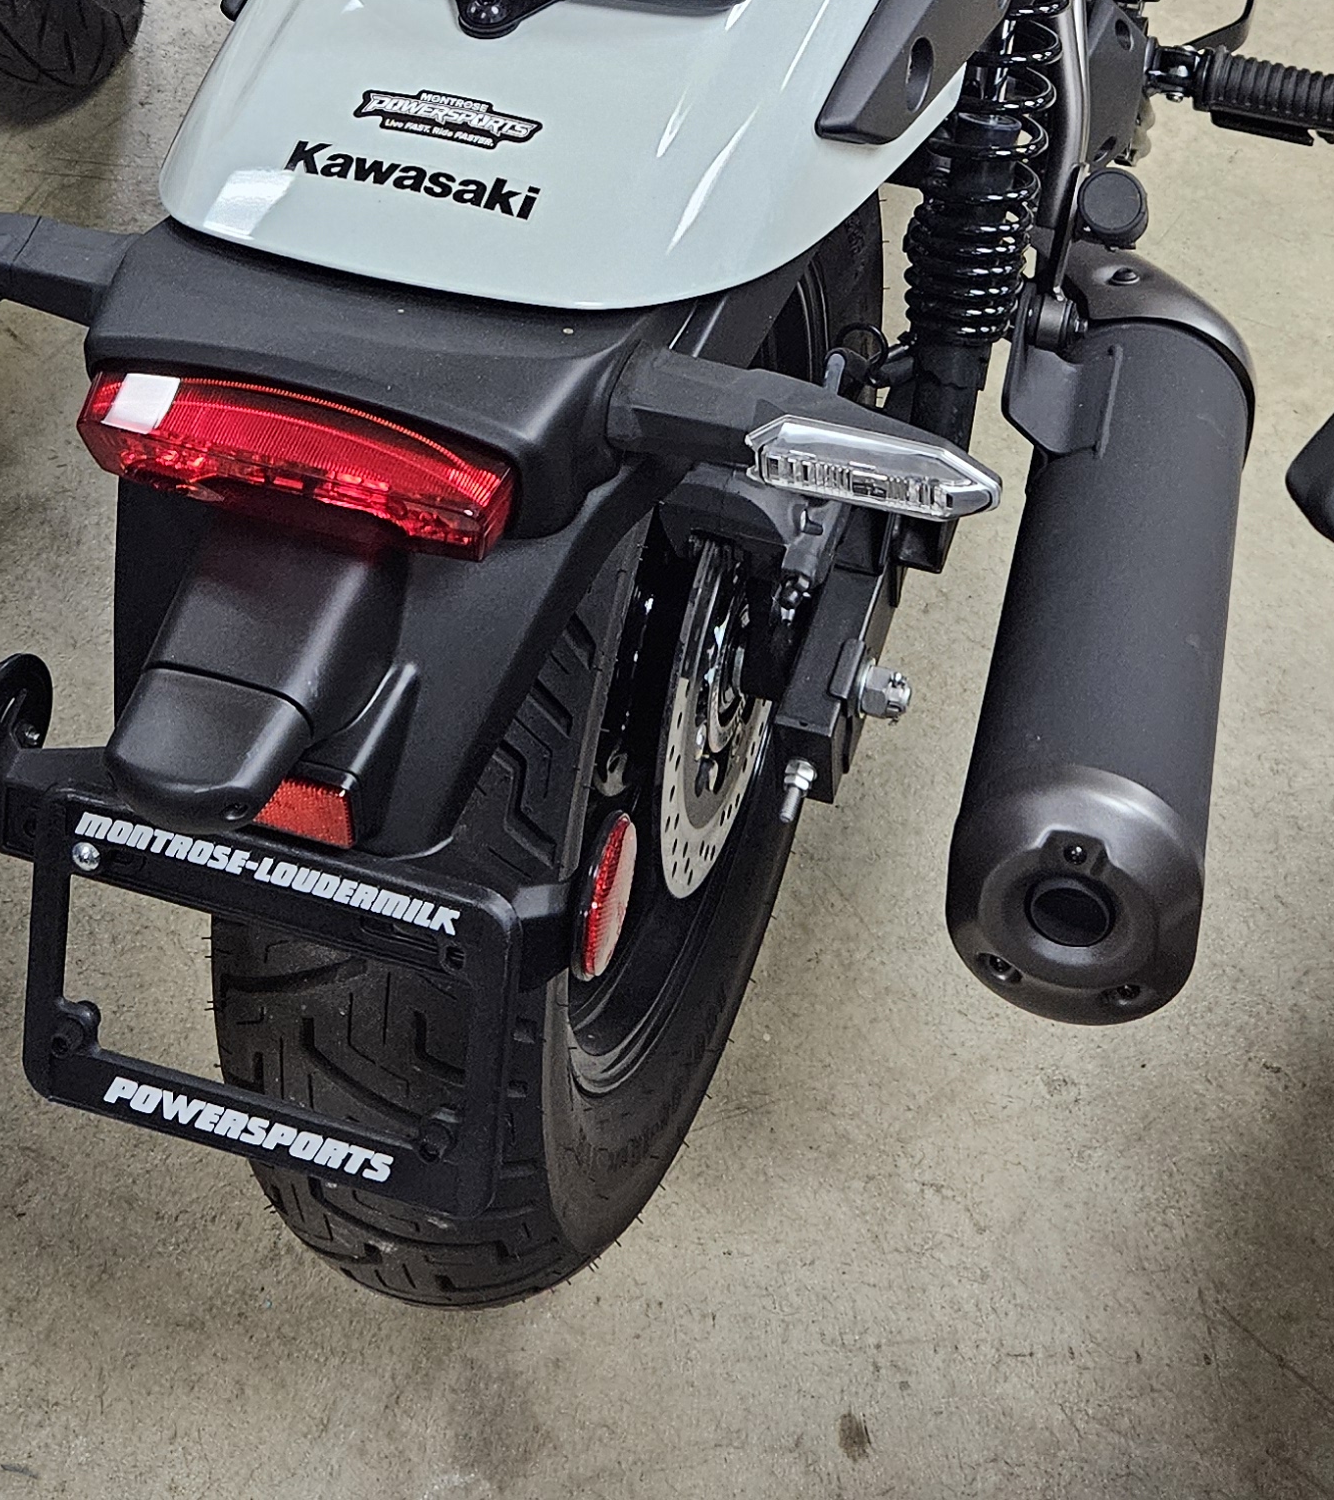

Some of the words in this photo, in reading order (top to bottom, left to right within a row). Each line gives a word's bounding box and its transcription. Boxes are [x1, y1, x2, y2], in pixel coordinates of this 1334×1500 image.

[361, 93, 539, 138] POWERSPORTS
[384, 118, 402, 129] Live
[404, 121, 431, 133] FAST.
[432, 126, 453, 138] Ride
[453, 130, 494, 147] FASTER.
[420, 92, 489, 113] MONTROSE
[284, 140, 541, 220] Kawasaki
[74, 811, 461, 936] MONTROSE-LOUDERMILK
[103, 1076, 394, 1182] POWERSPORTS
